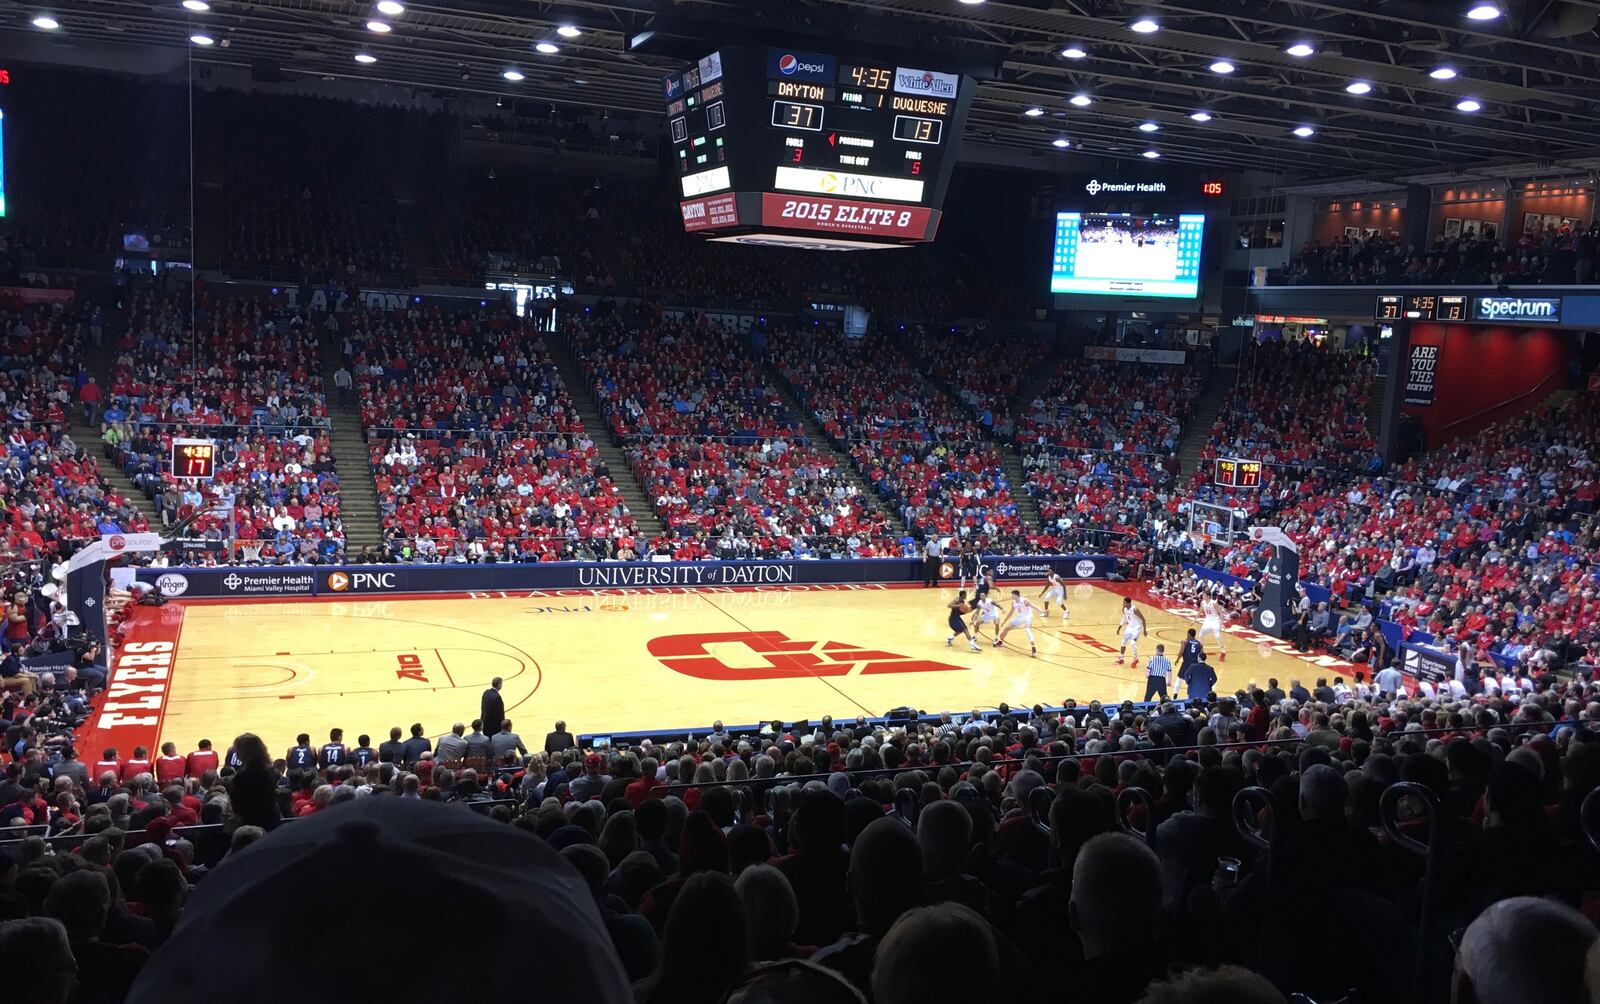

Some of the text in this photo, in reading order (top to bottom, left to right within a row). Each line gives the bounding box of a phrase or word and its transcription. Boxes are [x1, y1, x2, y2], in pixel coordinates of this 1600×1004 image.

[797, 62, 825, 74] pepsi
[853, 67, 892, 89] 4:35
[778, 82, 824, 100] DAYTON
[842, 92, 863, 103] PERIOD
[878, 94, 883, 108] 1
[893, 97, 948, 115] DUQUESNE
[788, 106, 813, 127] 37
[914, 121, 932, 140] 13
[785, 137, 804, 148] FOULS
[793, 149, 803, 162] 3
[839, 155, 869, 167] TIME OUT
[905, 151, 922, 160] FOULS
[911, 162, 921, 175] 5
[843, 177, 882, 195] PNC
[1102, 182, 1166, 192] Premier Health
[1204, 183, 1221, 194] 1:05
[782, 201, 911, 227] 2015 ELITE 8
[1412, 297, 1435, 309] 4:35
[1481, 298, 1551, 319] Spectrum
[1384, 306, 1397, 318] 37
[1449, 307, 1460, 319] 13
[1411, 346, 1438, 359] ARE
[1411, 358, 1436, 371] YOU
[1410, 370, 1434, 383] THE
[188, 459, 205, 475] 17
[1223, 471, 1232, 484] 17
[1243, 473, 1256, 485] 17
[578, 565, 793, 585] UNIVERSITY of DAYTON
[1078, 562, 1093, 575] Kroger
[160, 577, 185, 593] Kroger
[244, 575, 313, 585] Premier Health
[353, 572, 396, 588] PNC
[265, 585, 283, 593] Valley
[285, 584, 310, 592] Hospital
[469, 583, 888, 599] BLACKBURN COURT
[1190, 644, 1196, 653] 5
[396, 654, 429, 683] A10
[1403, 665, 1417, 673] DEAN
[97, 641, 175, 729] FLYERS
[299, 752, 304, 764] 2
[327, 750, 338, 763] 14
[361, 755, 366, 768] 1
